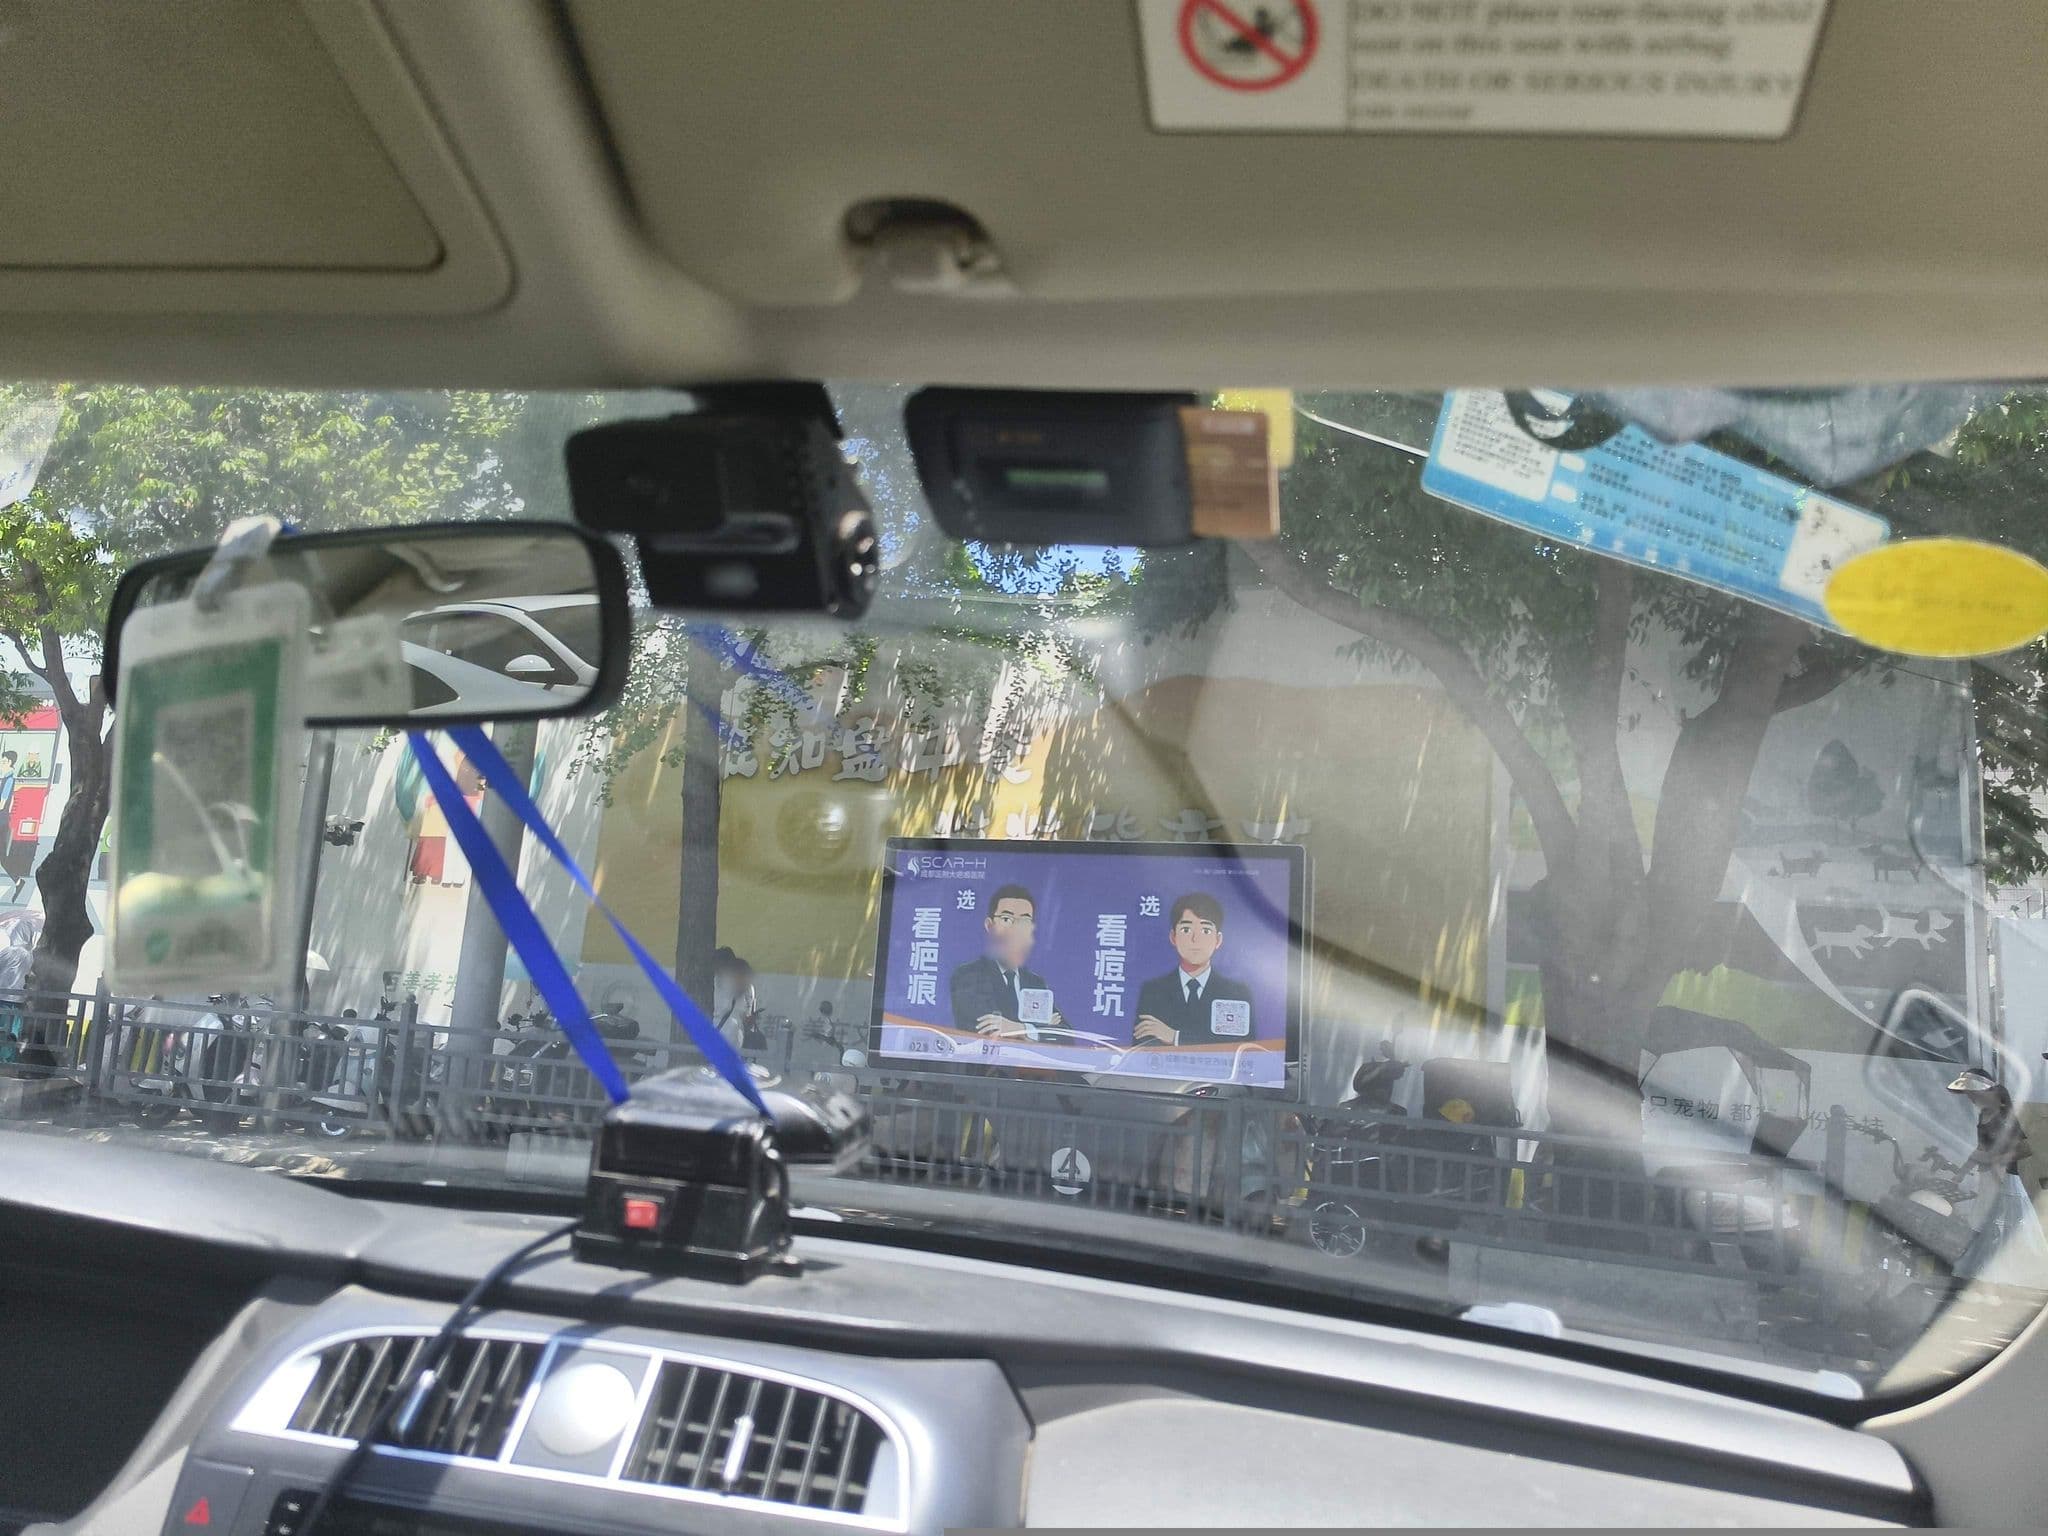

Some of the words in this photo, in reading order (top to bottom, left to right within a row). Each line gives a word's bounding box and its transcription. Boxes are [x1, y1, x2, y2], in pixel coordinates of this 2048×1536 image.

[957, 889, 976, 910] 选
[1139, 895, 1161, 917] 选
[907, 907, 942, 1006] 看疤痕
[1093, 913, 1128, 1017] 看痘坑
